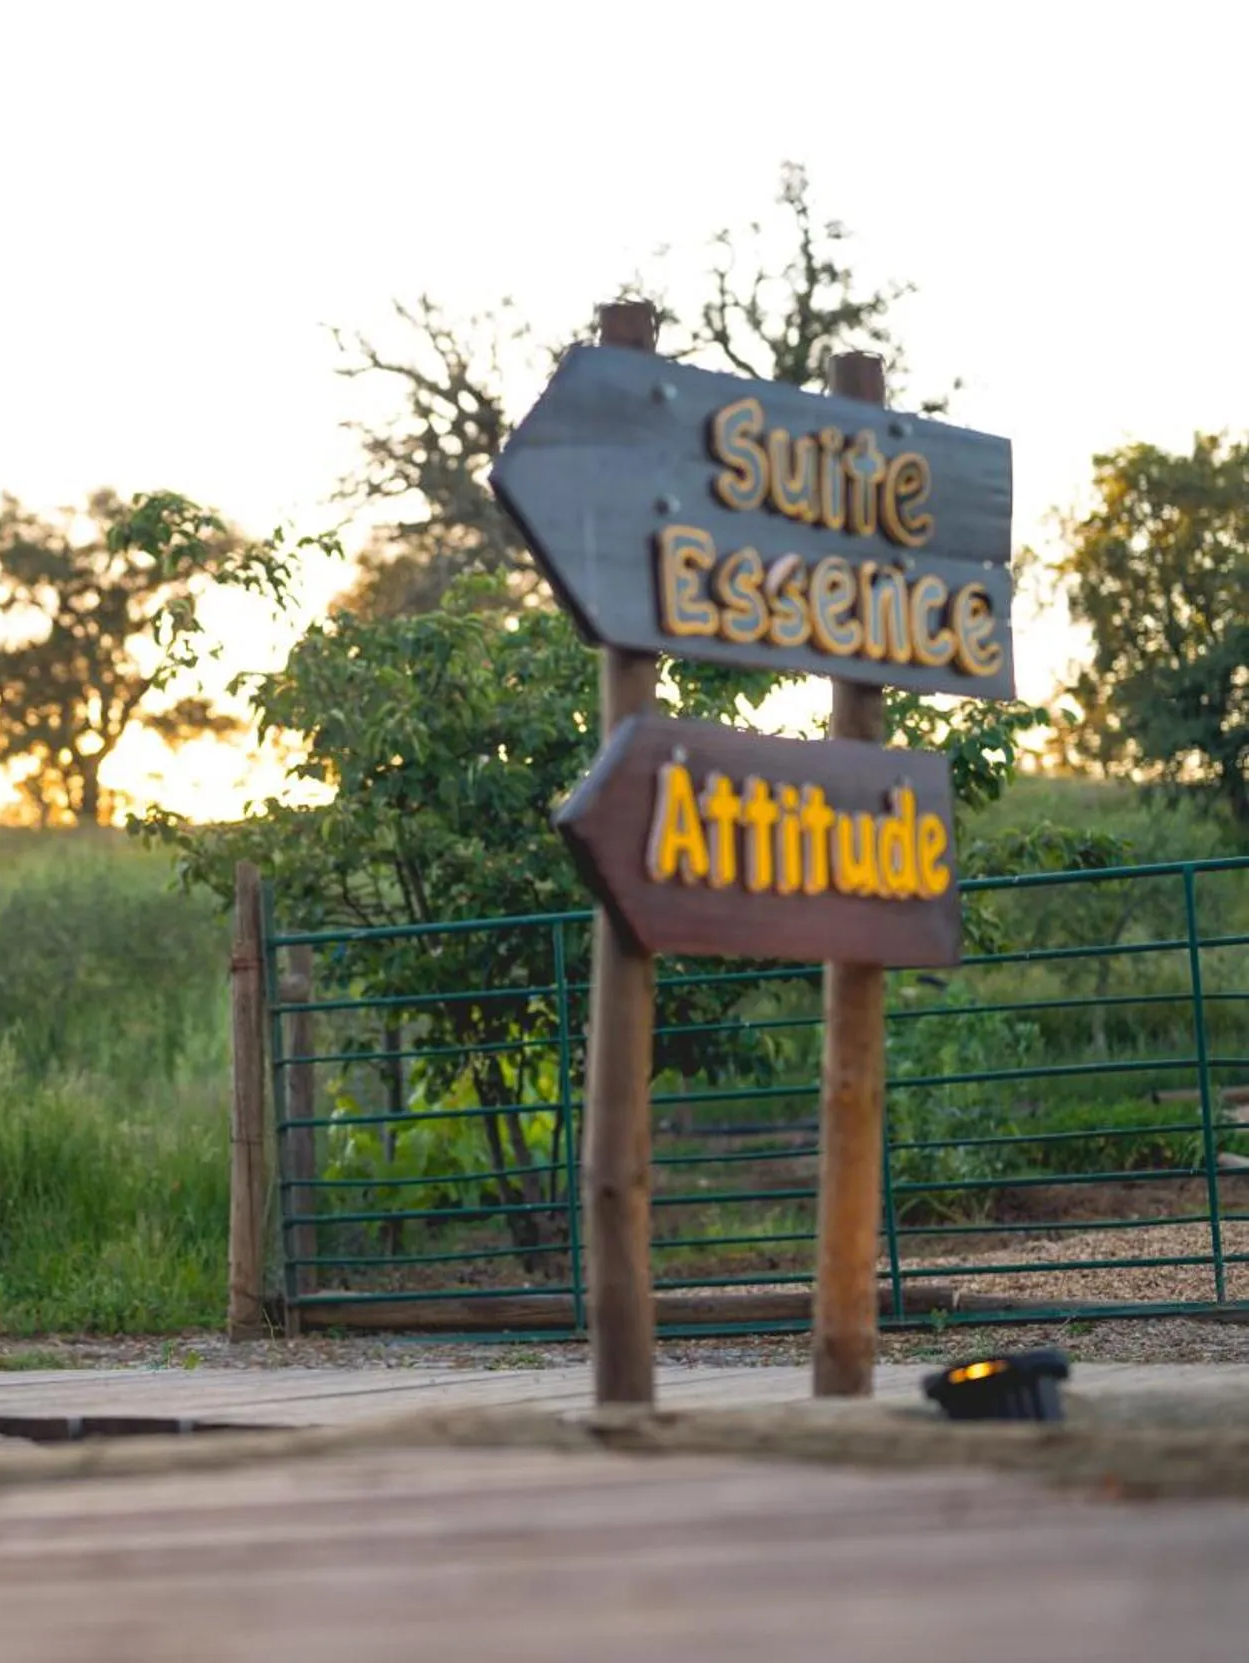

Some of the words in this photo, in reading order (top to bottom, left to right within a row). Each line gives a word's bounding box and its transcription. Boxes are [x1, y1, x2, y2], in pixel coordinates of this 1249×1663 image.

[711, 397, 935, 547] Suite
[657, 525, 1003, 676] Essence
[648, 763, 950, 899] Attitude
